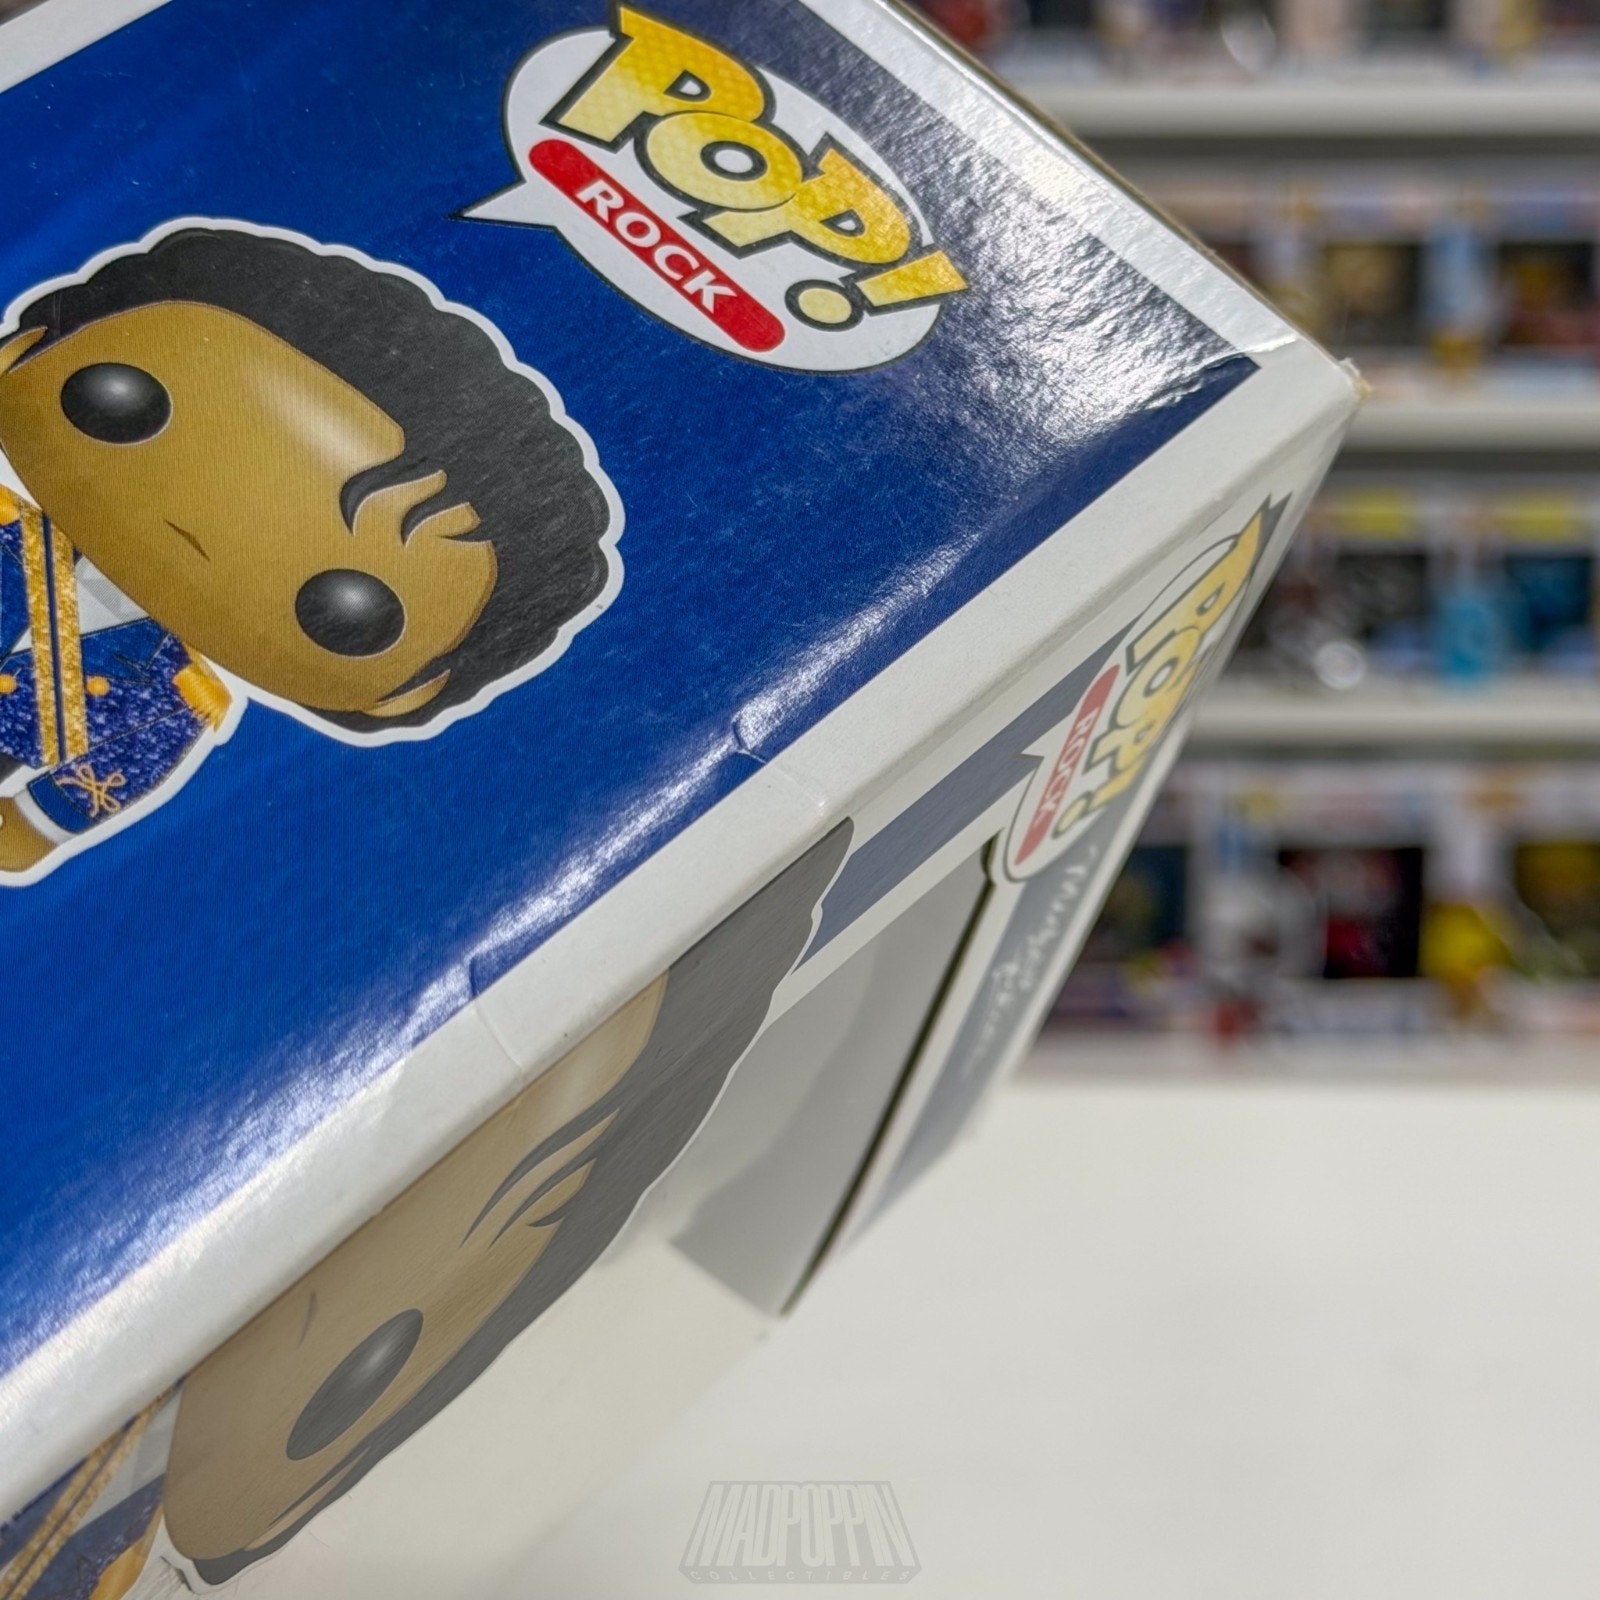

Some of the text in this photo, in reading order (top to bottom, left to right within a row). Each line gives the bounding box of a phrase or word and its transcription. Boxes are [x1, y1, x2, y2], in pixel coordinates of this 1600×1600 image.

[541, 3, 968, 331] POP!
[577, 178, 736, 314] ROCK
[1052, 498, 1274, 838] POP!
